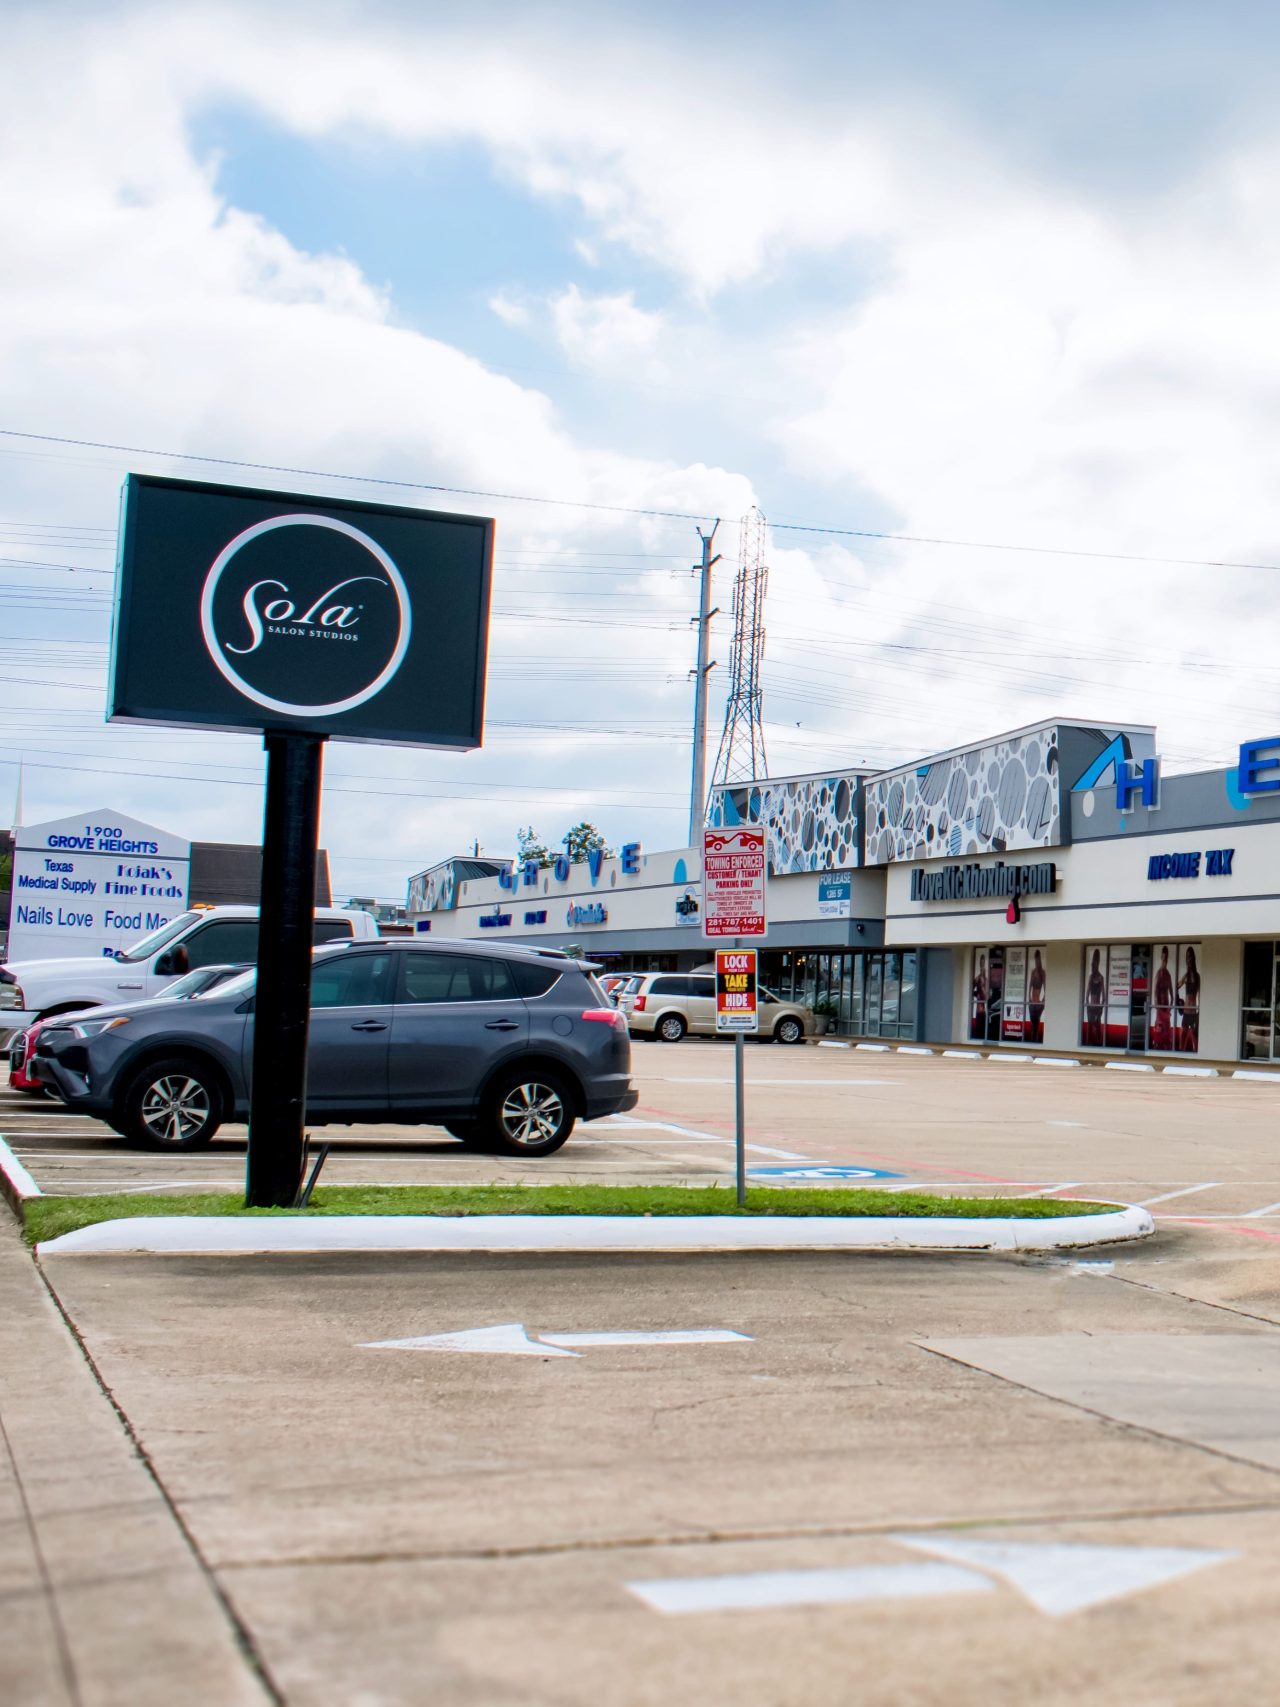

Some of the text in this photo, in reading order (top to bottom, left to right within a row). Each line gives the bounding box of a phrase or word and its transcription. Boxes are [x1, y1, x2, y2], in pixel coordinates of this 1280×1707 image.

[226, 576, 388, 654] Sola
[268, 626, 358, 642] SALON STUDIOS
[85, 826, 122, 838] 1900
[48, 835, 158, 854] GROVE HEIGHTS
[45, 859, 74, 872] Texas
[498, 842, 640, 888] GROVE
[706, 855, 763, 869] TOWING ENFORCED
[1148, 849, 1235, 880] INCOME TAX
[117, 865, 172, 880] Kojak's
[708, 870, 737, 879] CUSTOMER
[742, 870, 761, 878] TENANT
[820, 872, 851, 885] FOR LEASE
[19, 875, 96, 894] Medical Supply
[104, 882, 183, 898] Fine Foods
[716, 880, 739, 888] PARKING
[17, 905, 93, 927] Nails Love
[105, 910, 142, 929] Food
[708, 918, 762, 926] 281-787-1401
[724, 955, 748, 969] LOCK
[724, 974, 748, 987] TAKE
[726, 993, 748, 1007] HIDE
